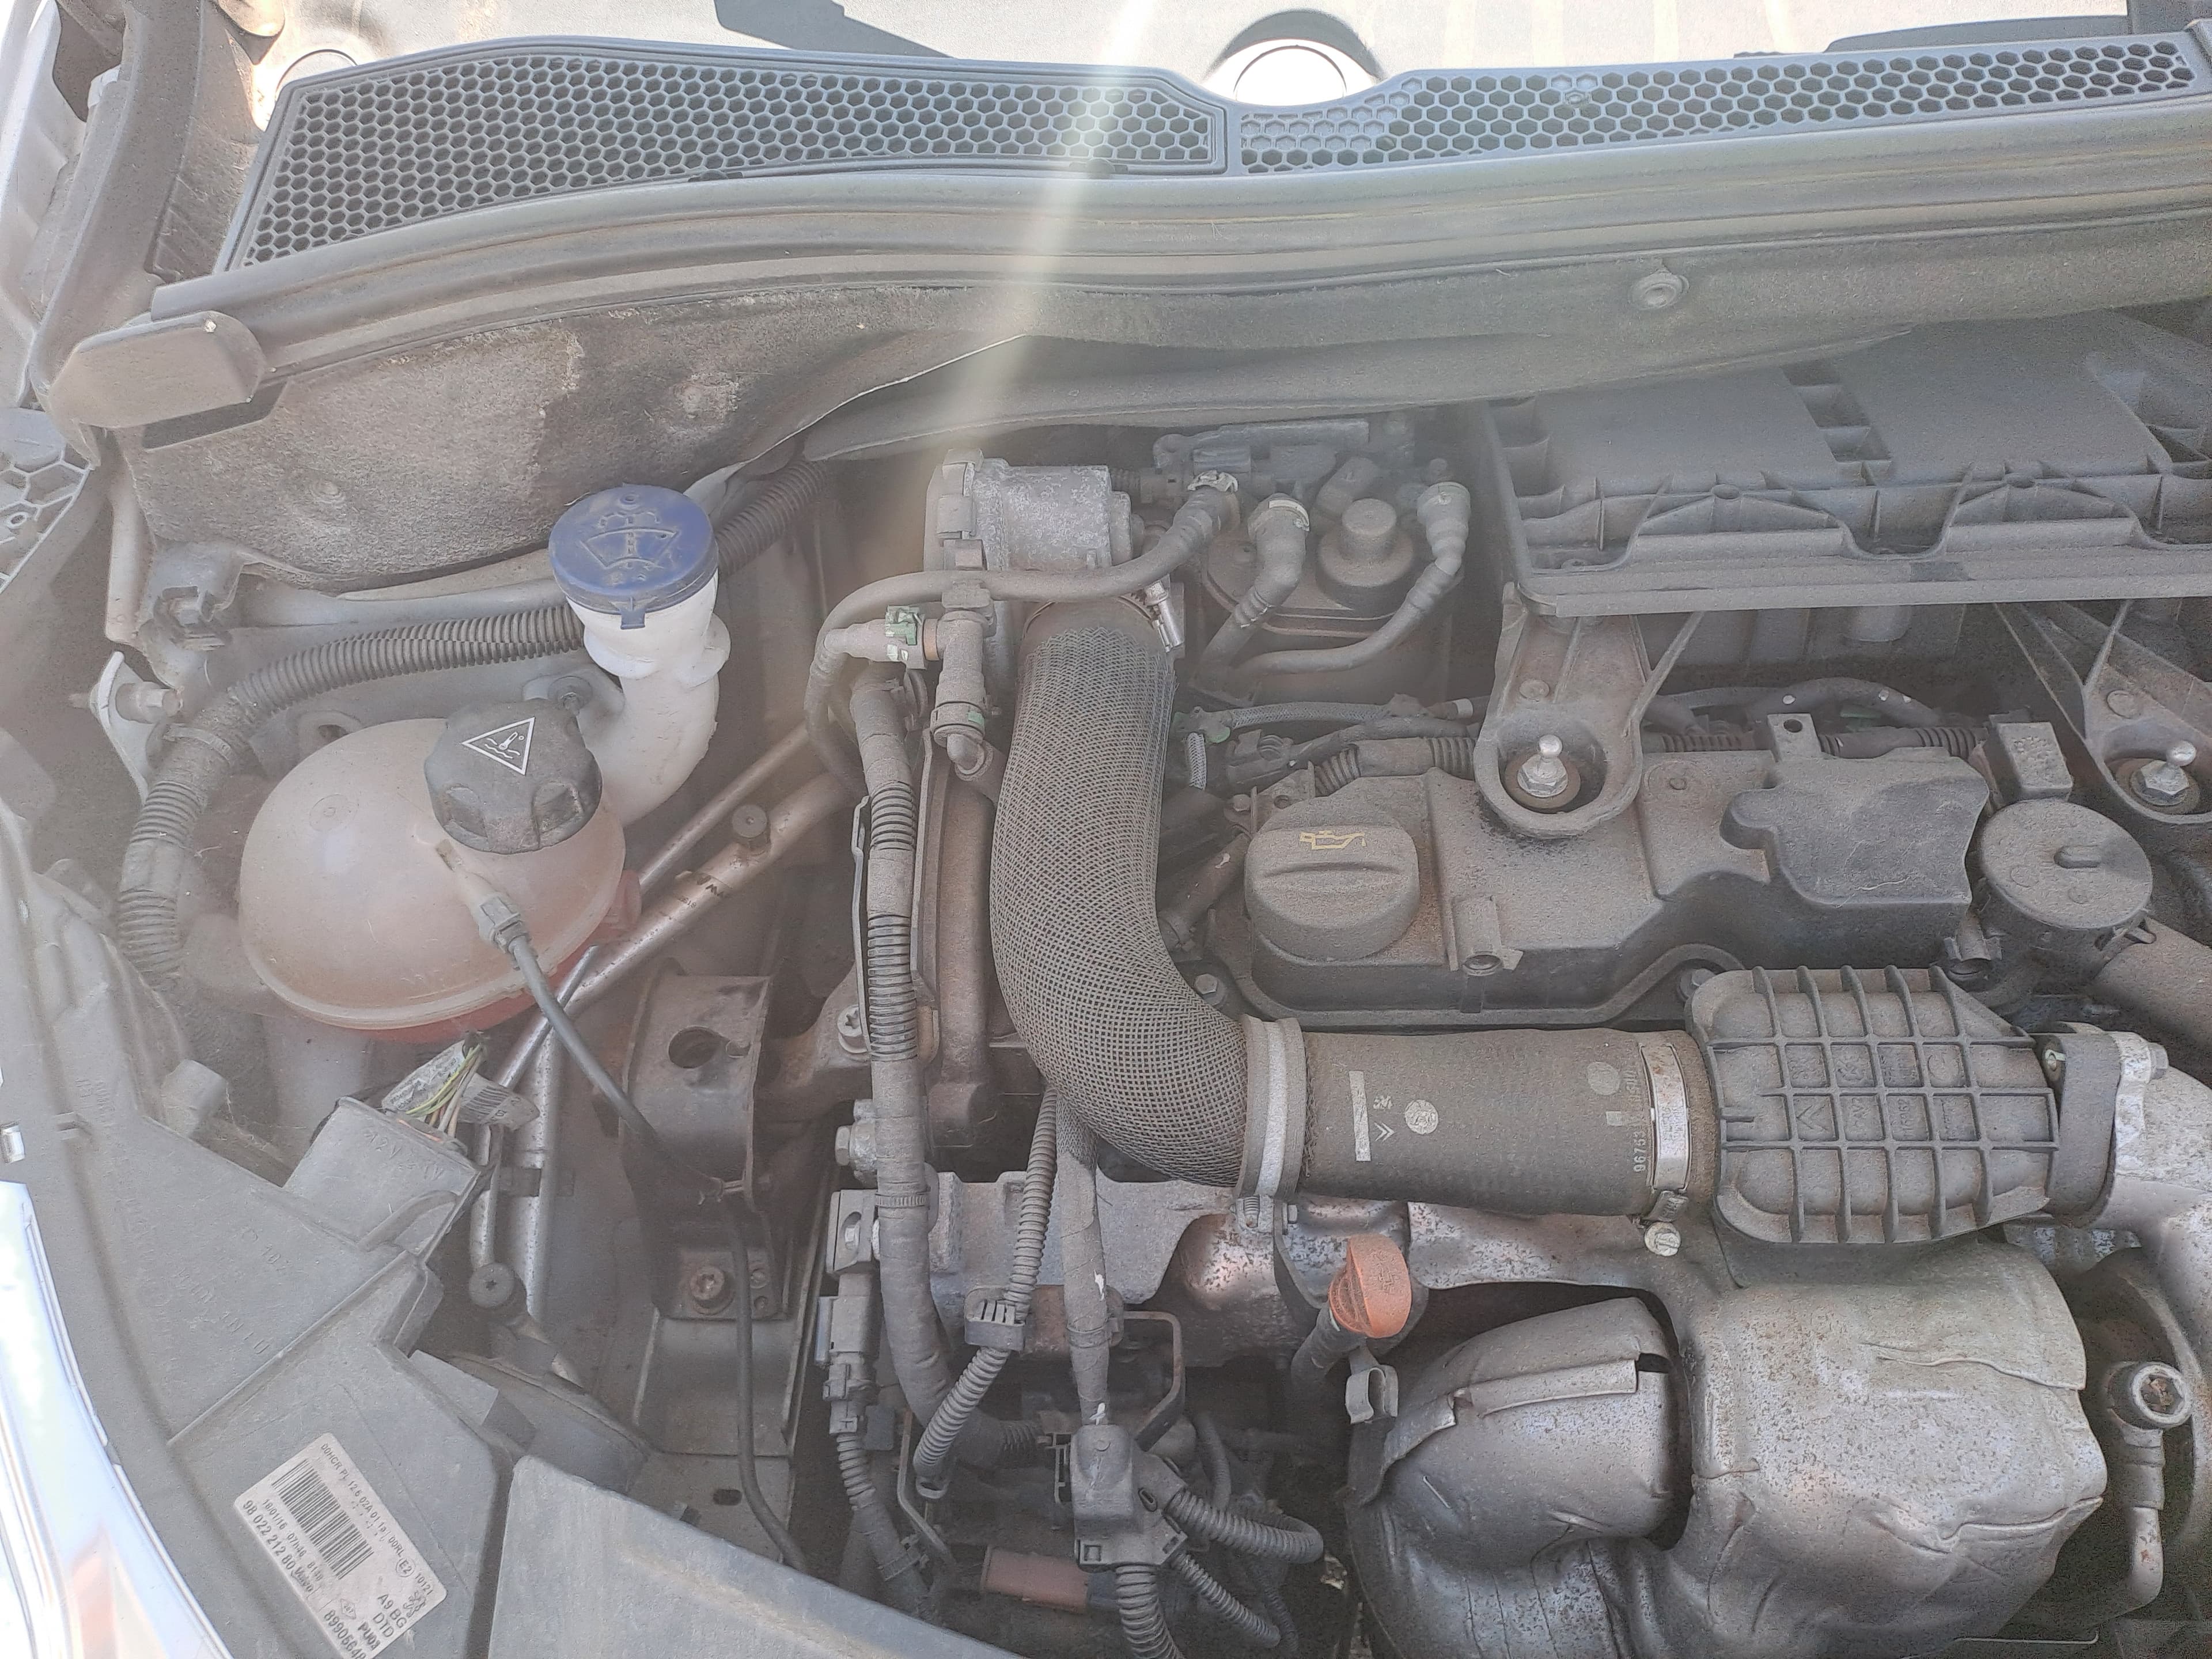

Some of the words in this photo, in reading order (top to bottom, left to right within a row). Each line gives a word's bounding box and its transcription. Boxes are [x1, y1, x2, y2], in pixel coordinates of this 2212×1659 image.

[241, 1499, 257, 1516] 98
[252, 1514, 272, 1536] 022
[266, 1534, 286, 1556] 212
[281, 1554, 297, 1570] 80
[399, 1560, 412, 1574] E2
[372, 1612, 396, 1638] DTD
[377, 1592, 395, 1610] A9
[389, 1608, 408, 1629] BG
